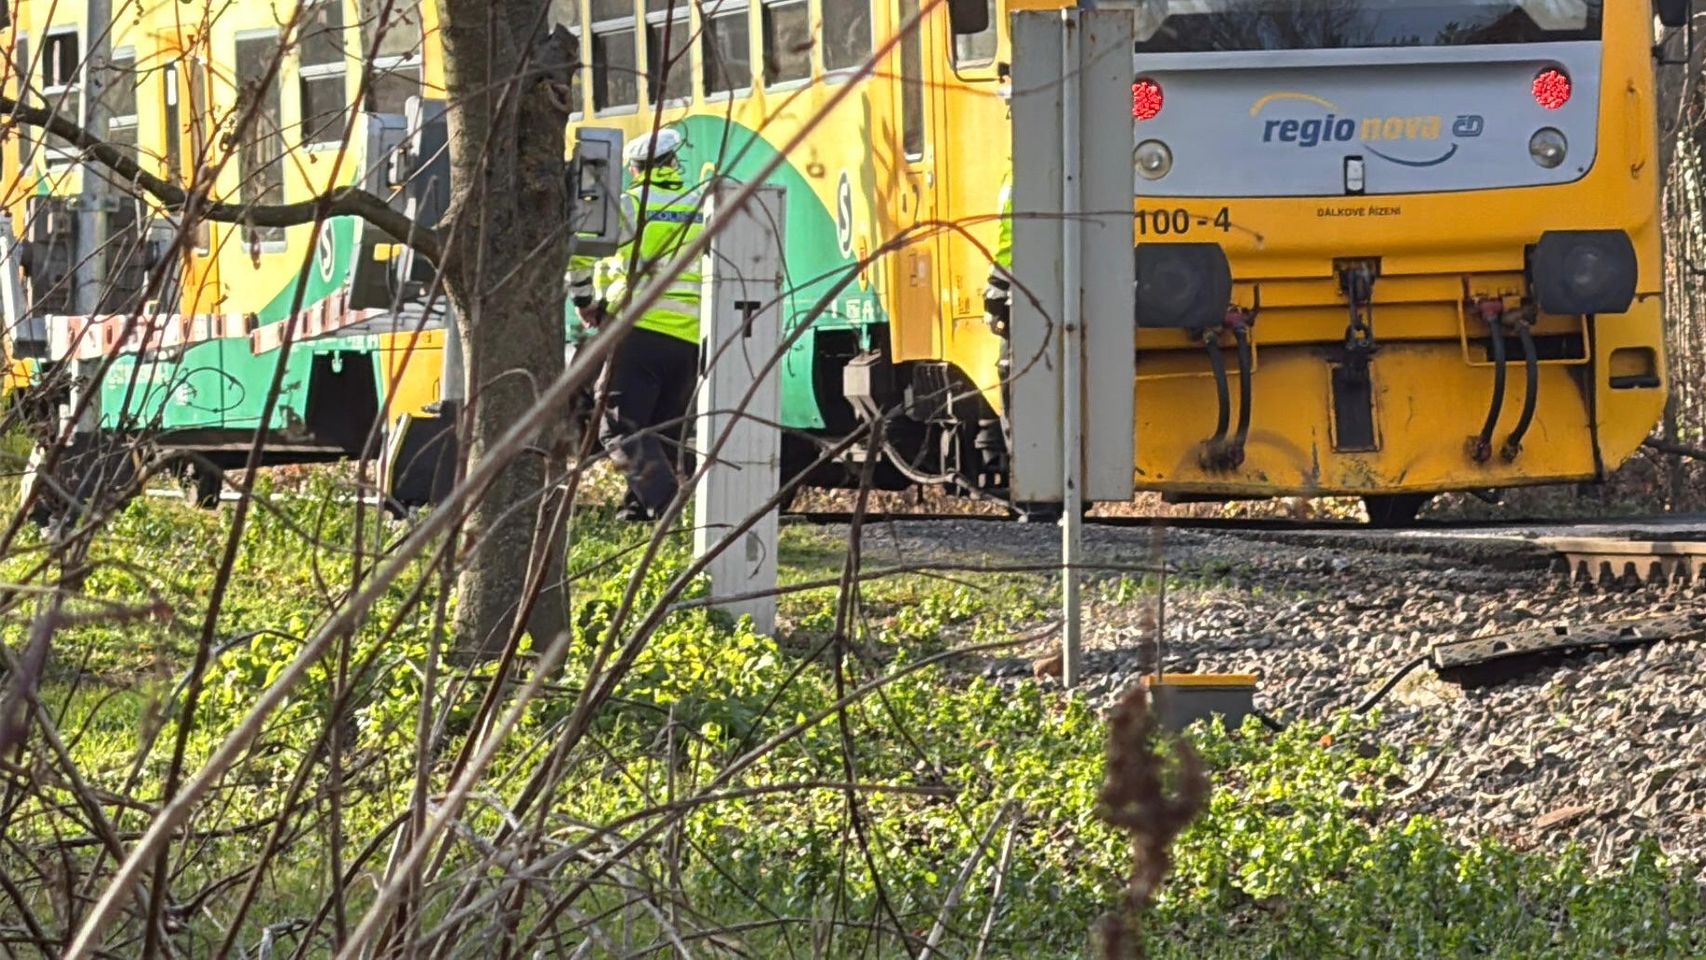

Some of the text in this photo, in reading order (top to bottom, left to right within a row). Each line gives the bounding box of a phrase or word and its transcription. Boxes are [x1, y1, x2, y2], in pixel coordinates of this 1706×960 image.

[1263, 114, 1355, 147] regio
[1359, 115, 1442, 141] nova
[735, 301, 761, 338] T
